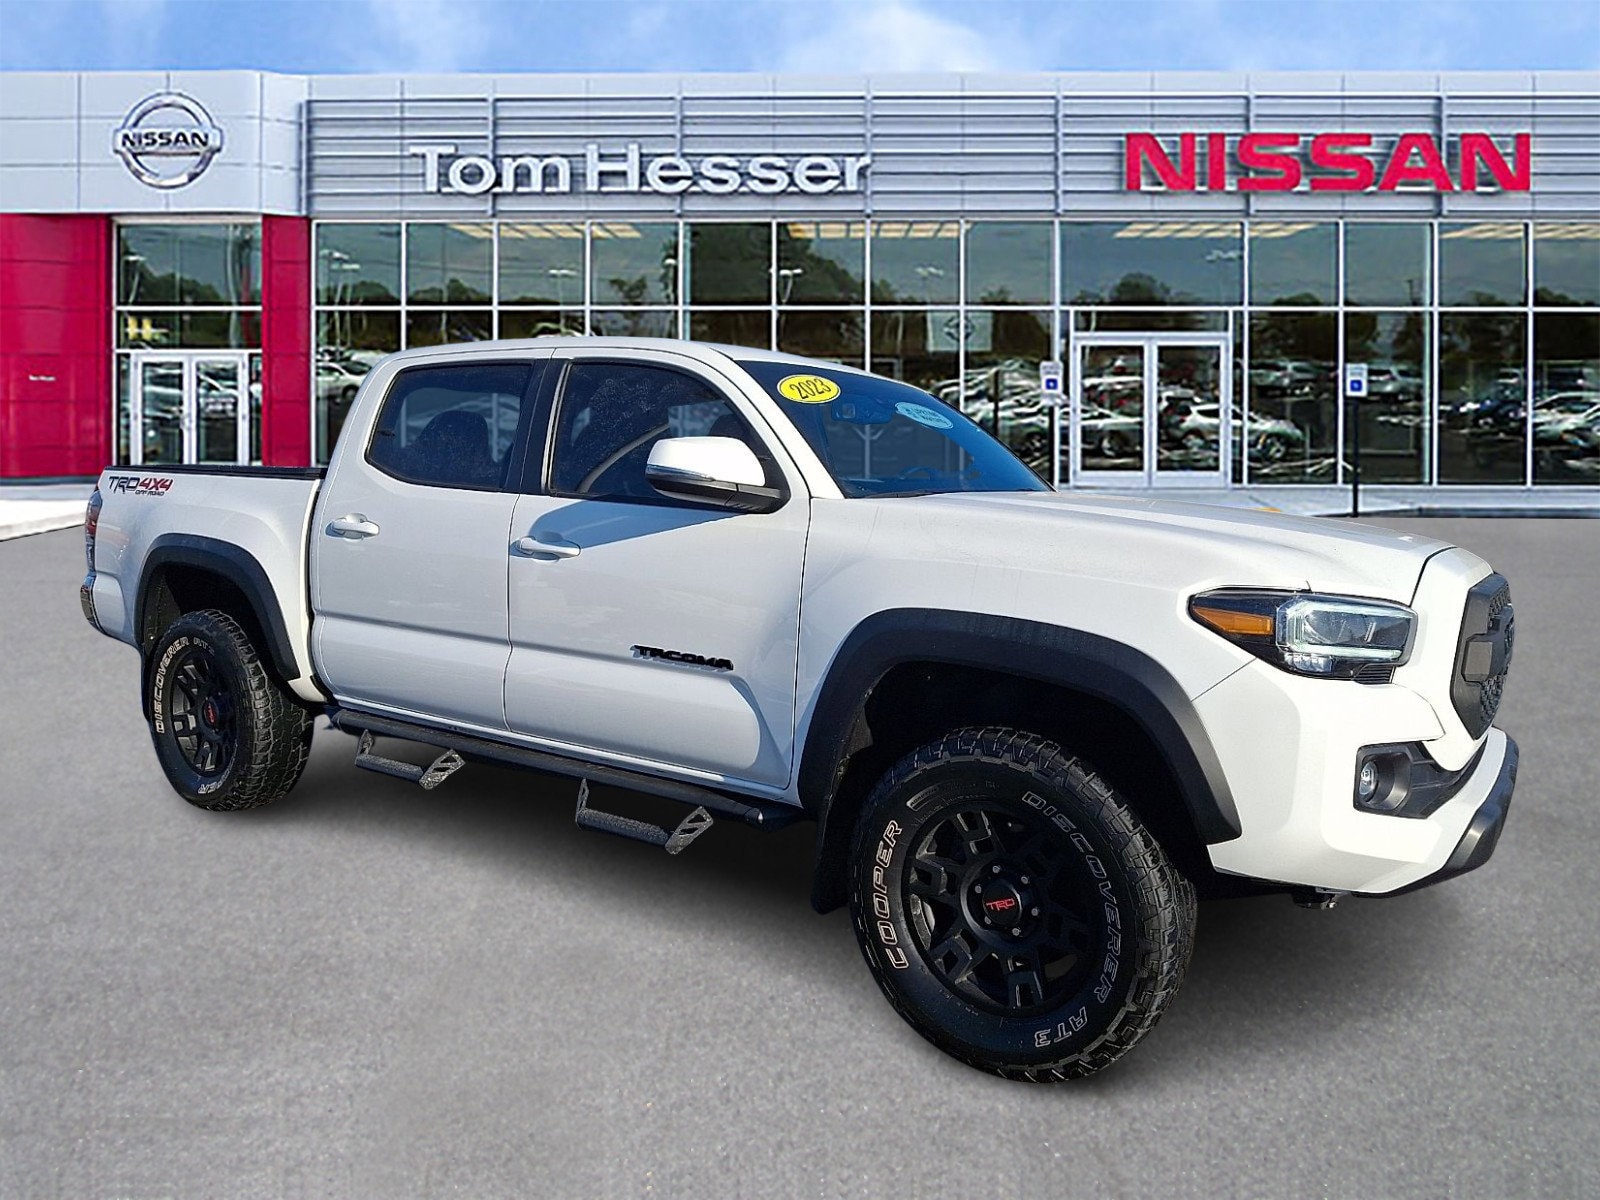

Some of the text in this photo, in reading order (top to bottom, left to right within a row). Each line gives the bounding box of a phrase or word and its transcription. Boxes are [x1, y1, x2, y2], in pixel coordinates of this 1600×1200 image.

[120, 131, 210, 148] NISSAN
[1125, 132, 1531, 192] NISSAN
[408, 142, 873, 195] Tom Hesser
[789, 378, 832, 399] 2023
[153, 636, 190, 734] DISCOVERER
[873, 819, 909, 969] COOPER
[985, 898, 1015, 911] TRD
[1022, 791, 1121, 1048] DISCOVERER AT3
